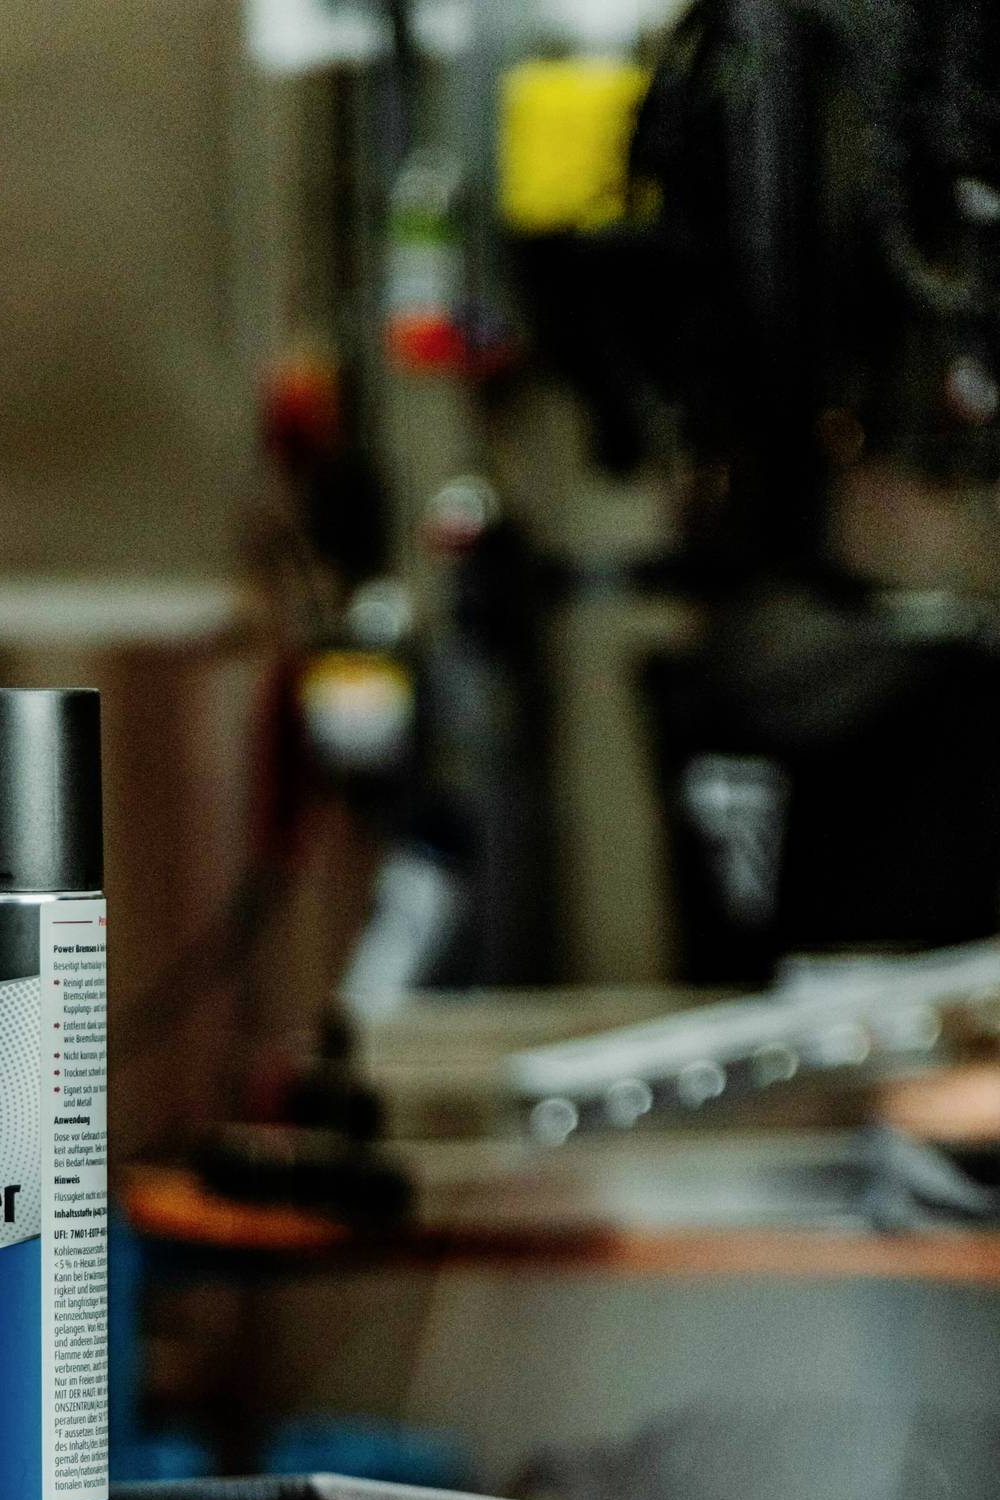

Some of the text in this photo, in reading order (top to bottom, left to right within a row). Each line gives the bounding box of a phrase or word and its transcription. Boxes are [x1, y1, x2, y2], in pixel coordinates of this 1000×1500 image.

[54, 945, 74, 953] Power
[63, 1052, 79, 1060] Nicht
[63, 1068, 87, 1077] Trocknet
[63, 1086, 82, 1096] Eignet
[63, 1098, 75, 1107] und
[54, 1114, 90, 1126] Anwendung
[54, 1132, 69, 1141] Dose
[54, 1159, 64, 1167] Bei
[66, 1158, 85, 1167] Bedarf
[54, 1230, 69, 1239] UFI:
[54, 1273, 72, 1282] Kann
[74, 1272, 83, 1281] bei
[77, 1285, 88, 1294] und
[54, 1299, 66, 1308] mit
[54, 1338, 68, 1348] und
[54, 1351, 81, 1360] Flamme
[54, 1378, 69, 1387] Nur
[55, 1390, 67, 1399] MIT
[69, 1389, 81, 1398] DER
[55, 1441, 67, 1451] des
[55, 1480, 82, 1491] tionalen
